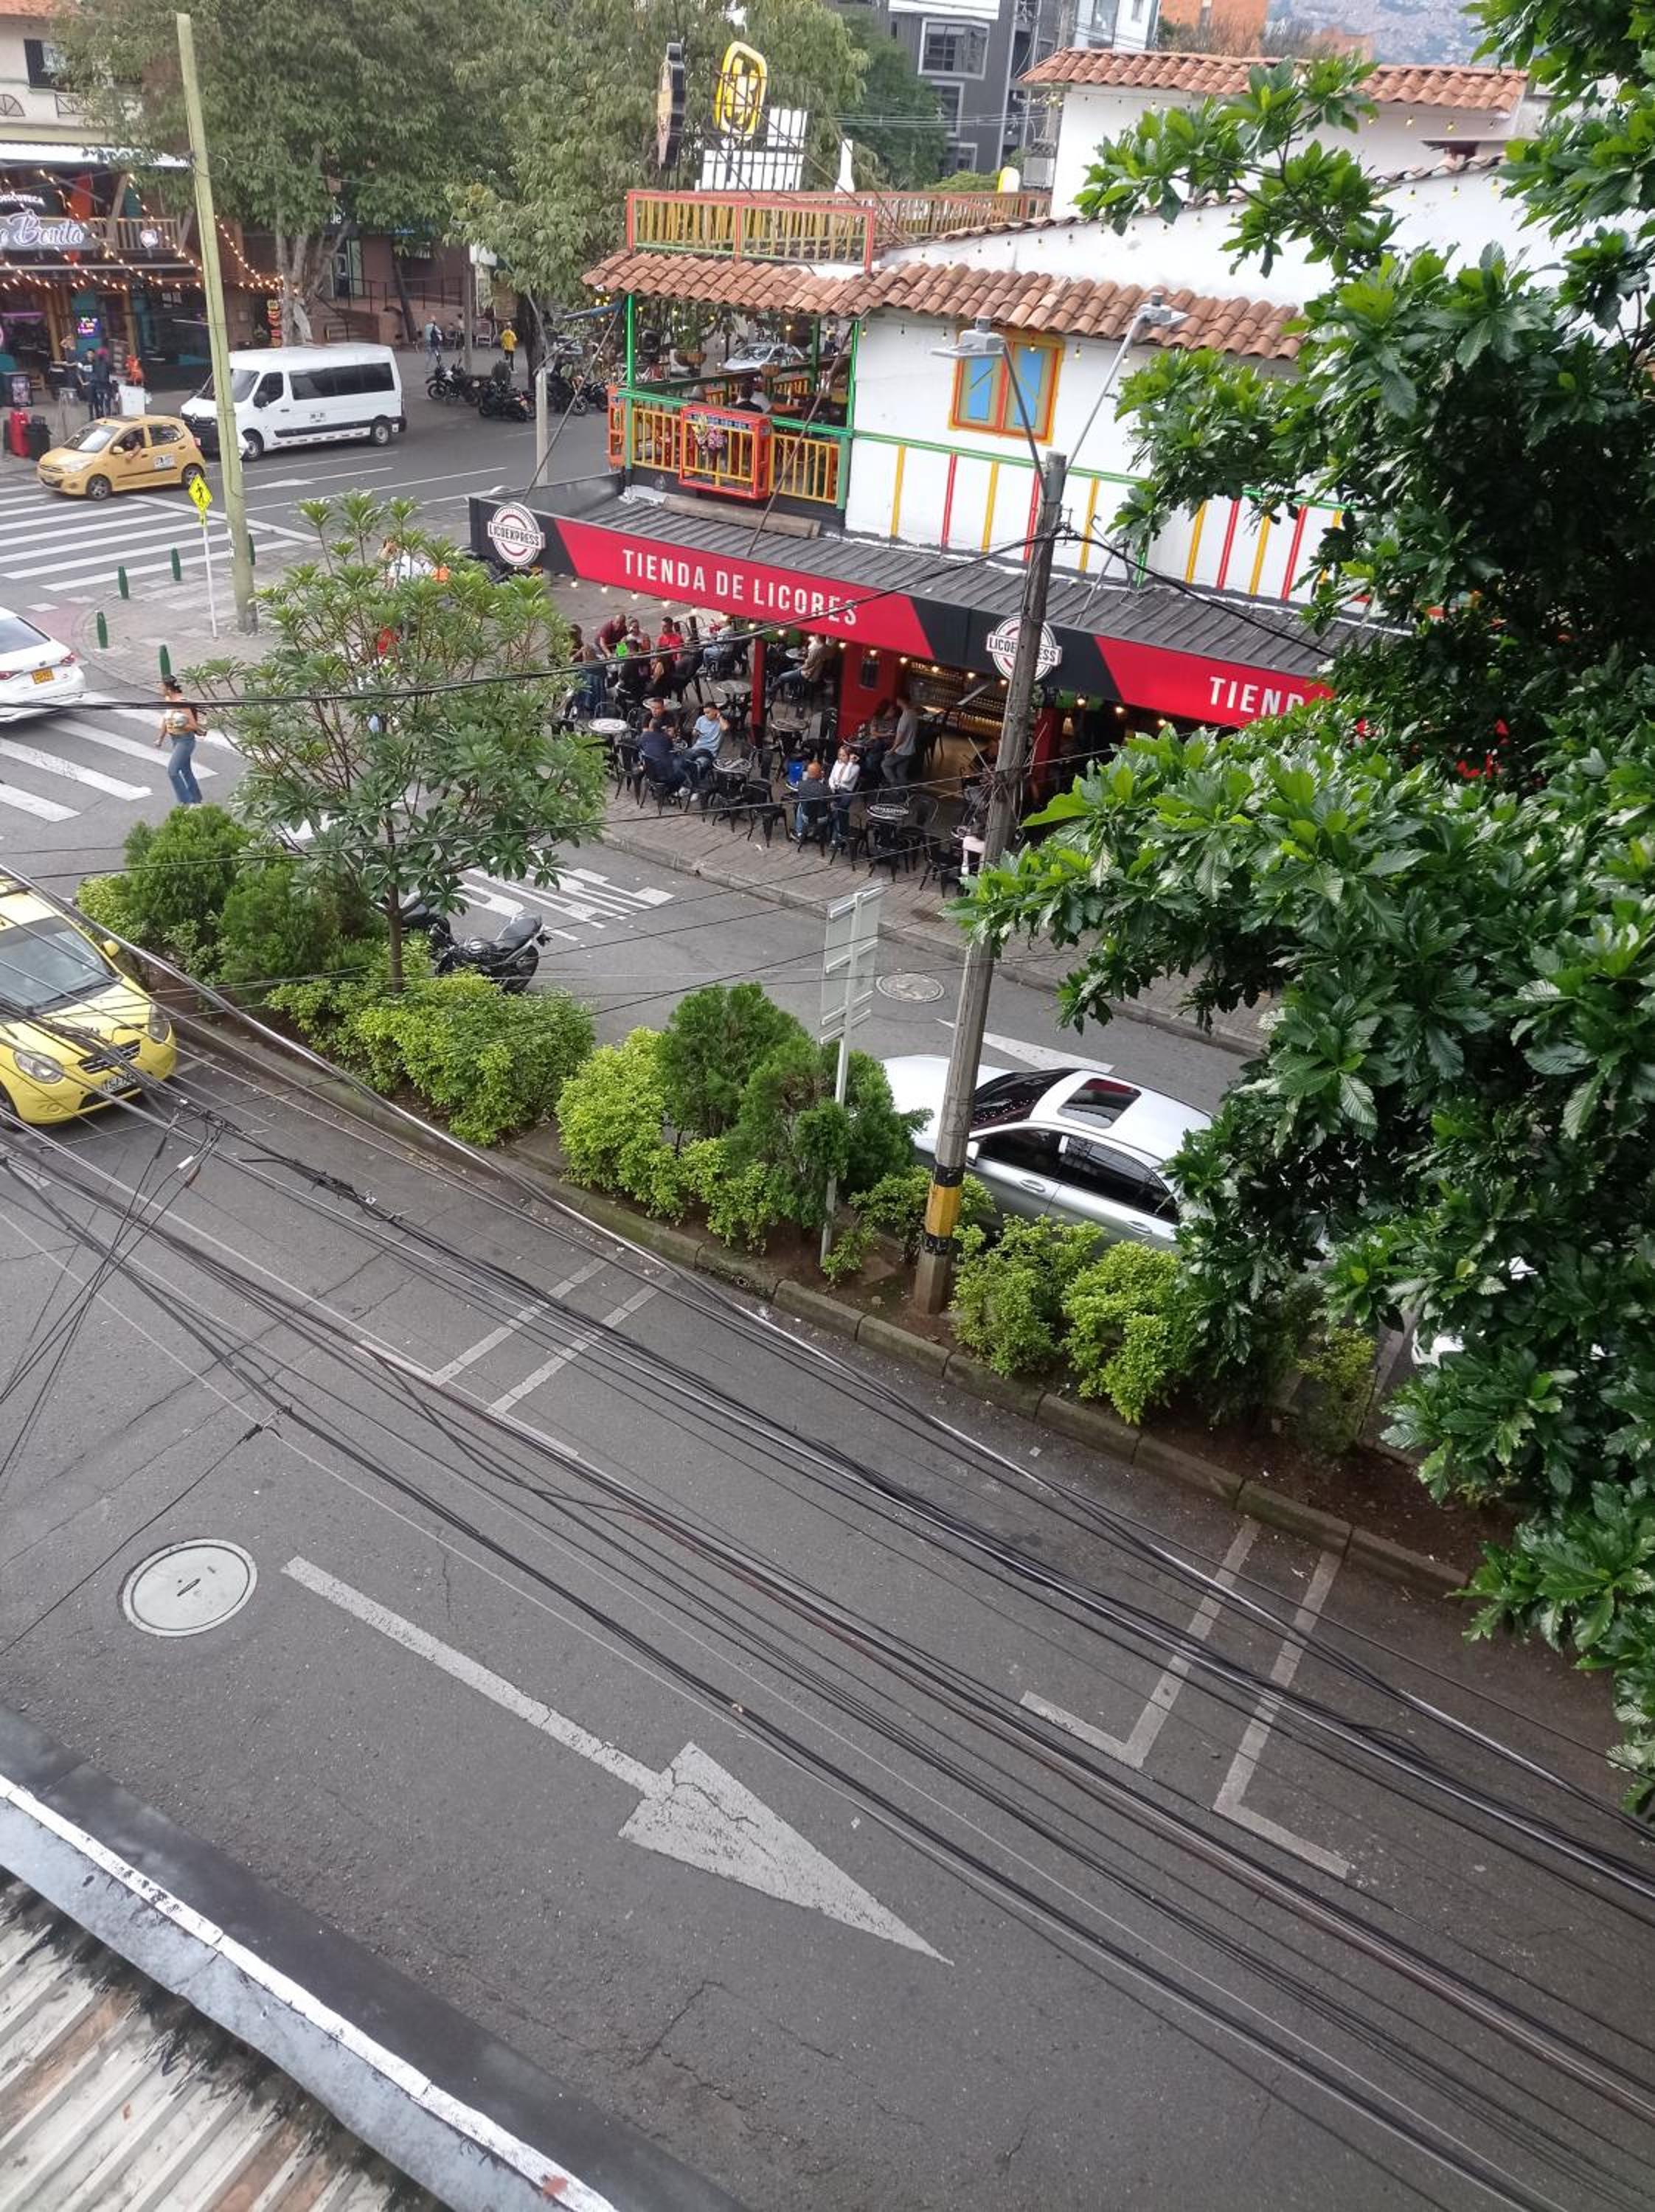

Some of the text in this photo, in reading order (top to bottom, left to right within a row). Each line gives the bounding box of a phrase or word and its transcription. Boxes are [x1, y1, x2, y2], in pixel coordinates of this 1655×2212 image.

[489, 524, 541, 547] LICOEXPRESS
[622, 549, 858, 626] TIENDA DE LICORES
[989, 636, 1058, 663] LICOEESS
[1209, 675, 1325, 717] TIEND
